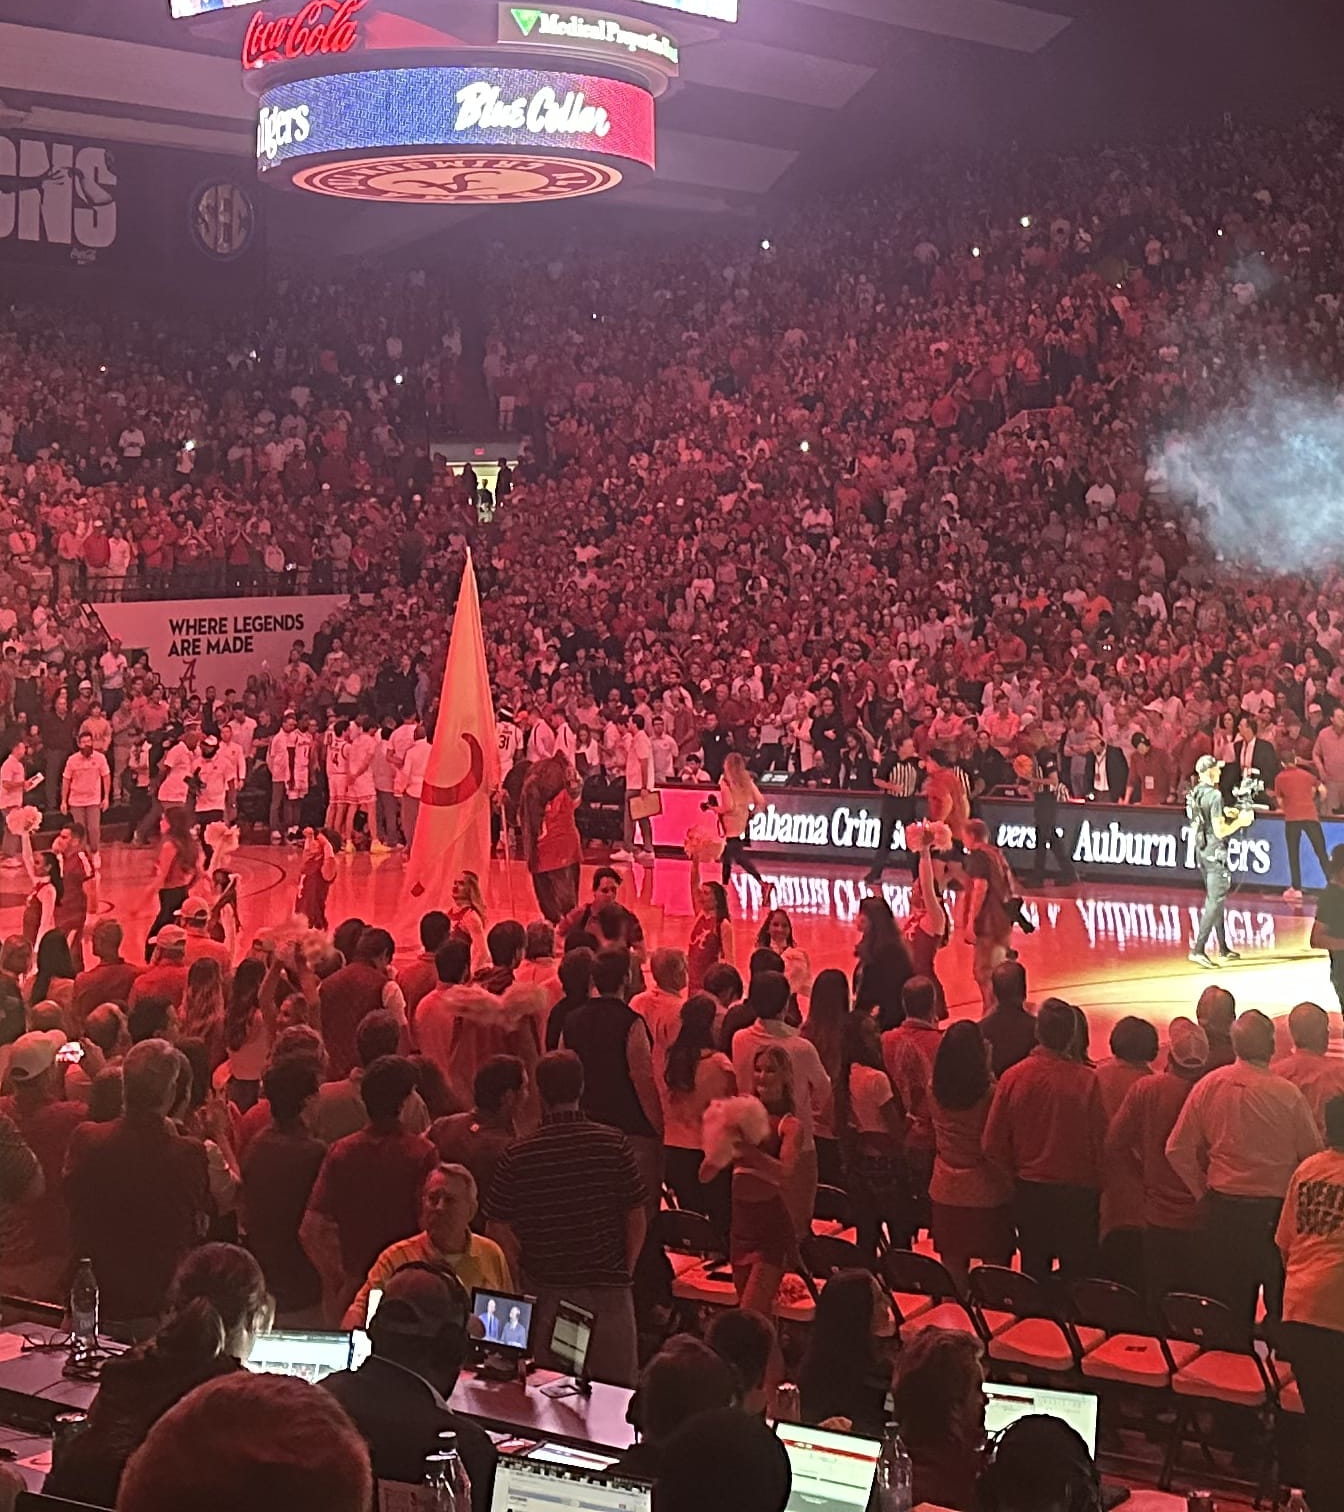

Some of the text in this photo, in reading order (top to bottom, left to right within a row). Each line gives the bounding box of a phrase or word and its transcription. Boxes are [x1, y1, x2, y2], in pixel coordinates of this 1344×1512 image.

[455, 81, 610, 137] Blue Collar
[169, 613, 304, 636] WHERE LEGENDS
[168, 636, 254, 657] ARE MADE
[1073, 820, 1271, 873] Auburn Ters
